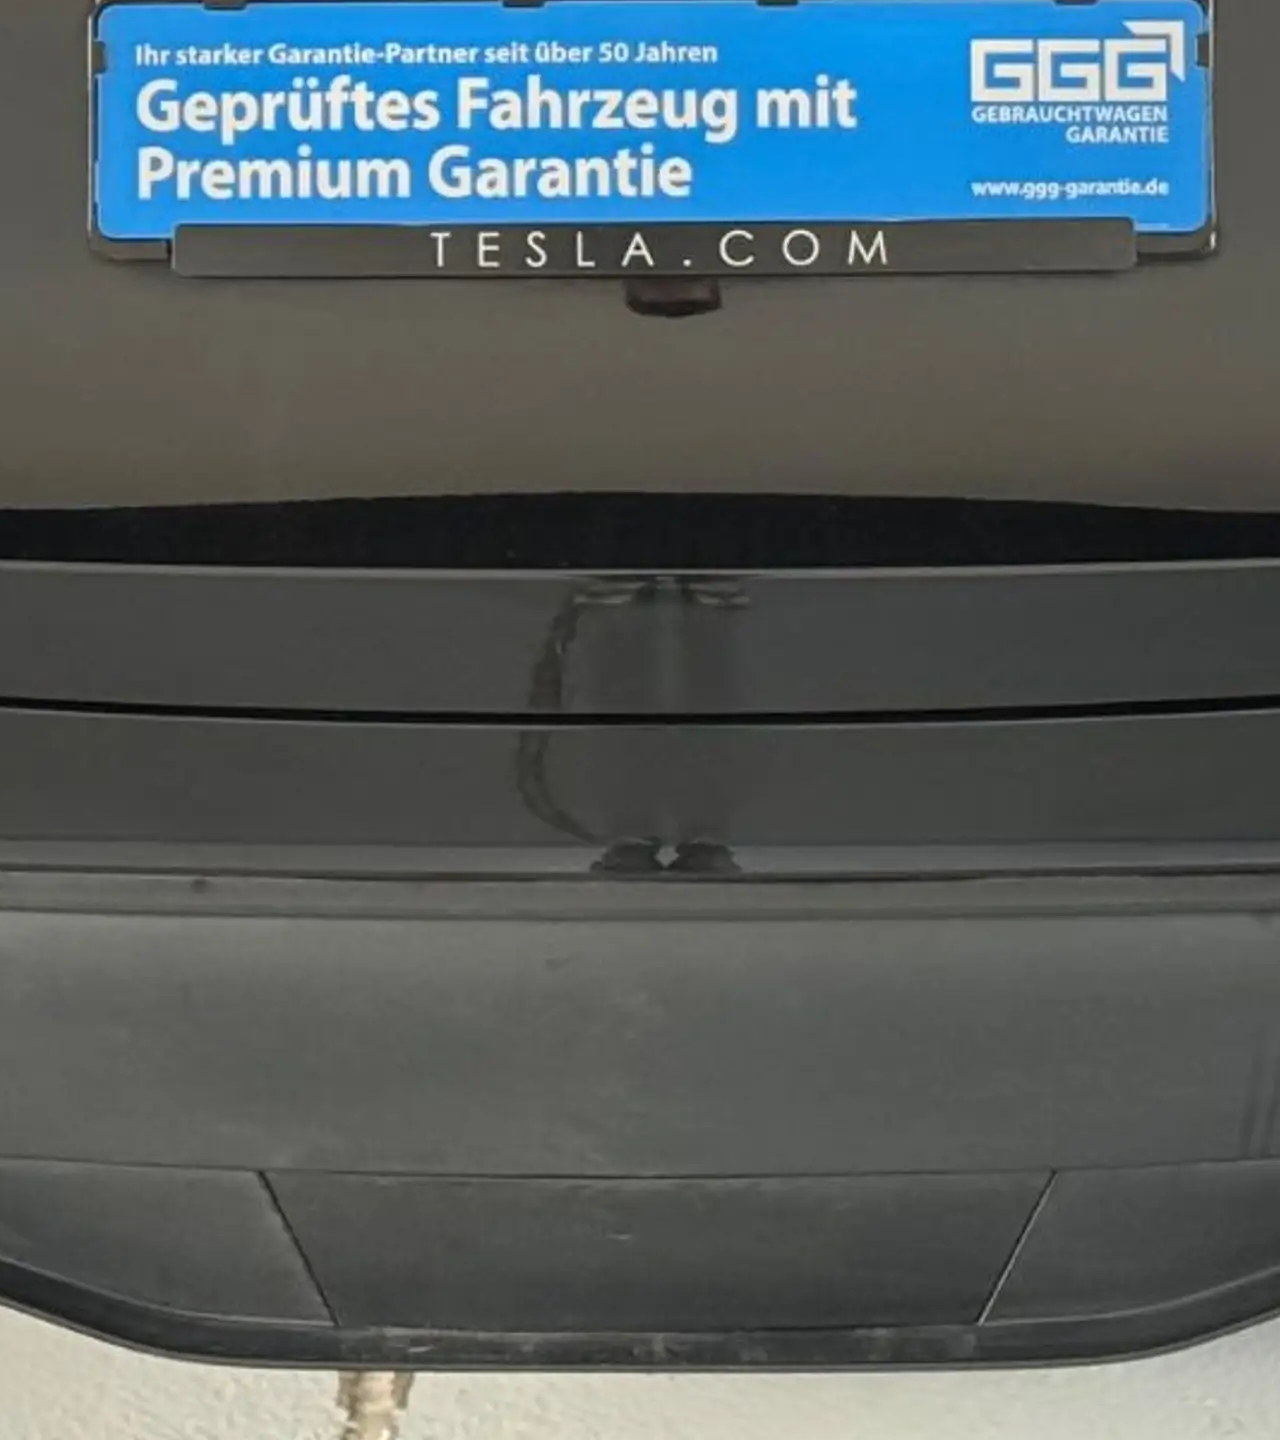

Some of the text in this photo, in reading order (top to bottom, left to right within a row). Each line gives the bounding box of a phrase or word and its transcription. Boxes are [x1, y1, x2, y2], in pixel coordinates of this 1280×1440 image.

[135, 41, 718, 66] Ihr starker Garantie-Partner seit über 50 Jahren
[970, 38, 1168, 102] GGG
[136, 74, 858, 145] Geprüftes Fahrzeug mit
[971, 105, 1168, 123] GEBRAUCHTWAGEN
[1065, 125, 1169, 144] GARANTIE
[137, 143, 694, 200] Premium Garantie
[971, 177, 1170, 200] www.ggg-garantie.de
